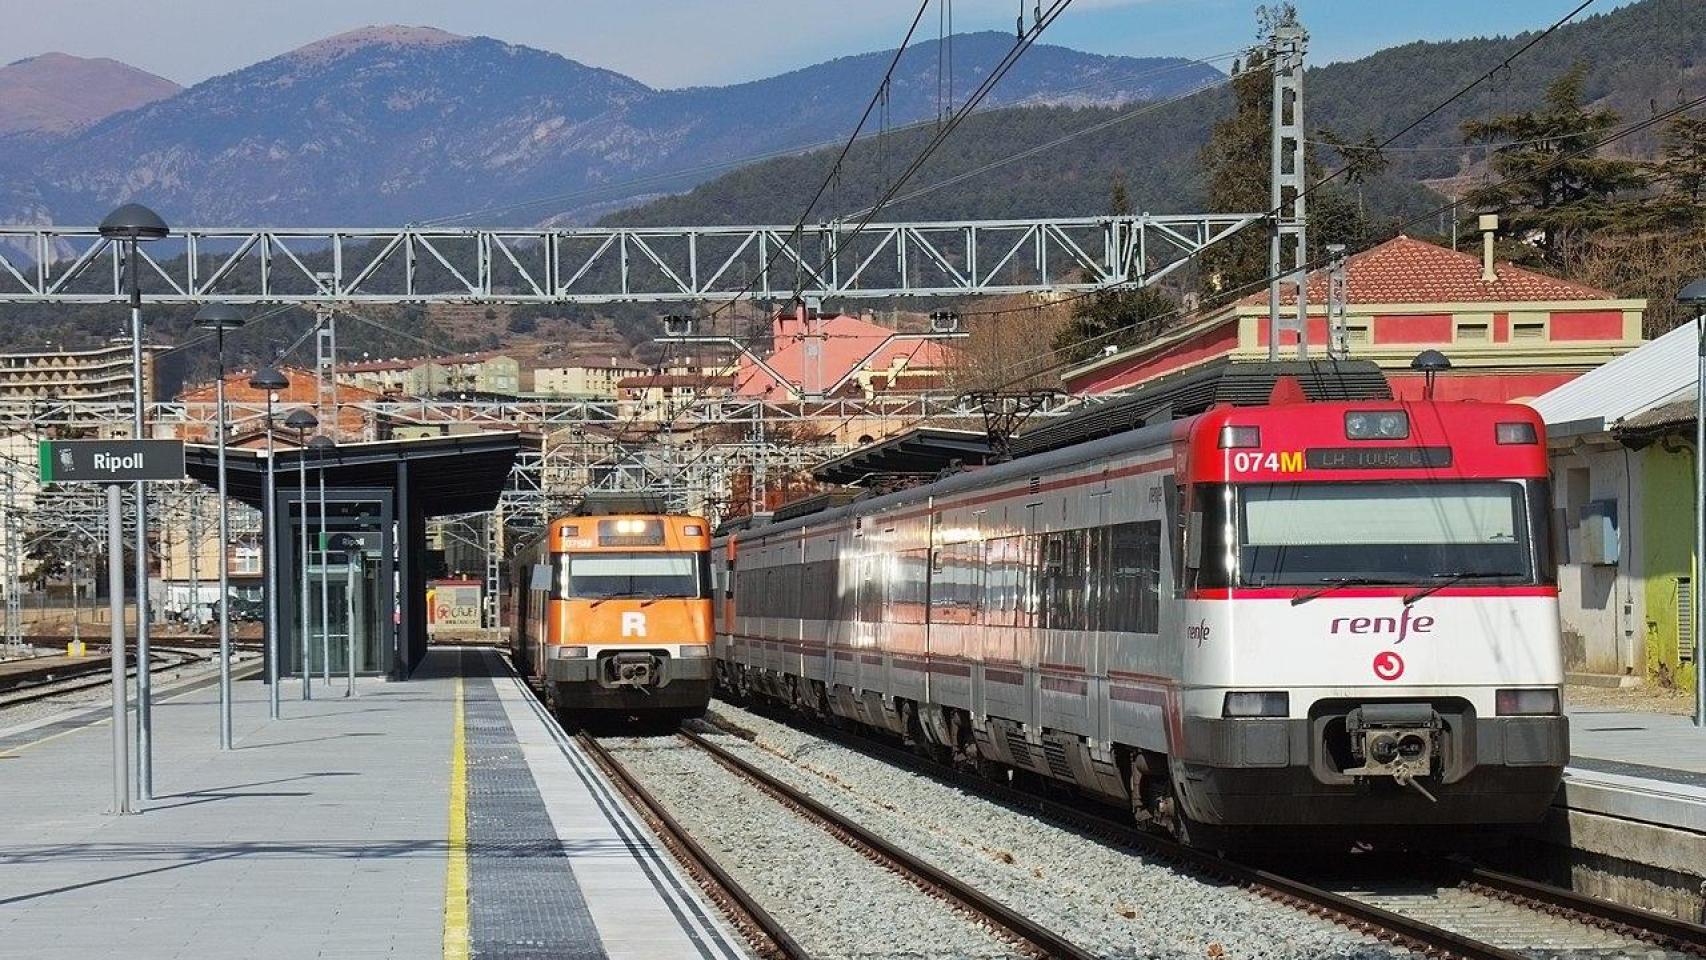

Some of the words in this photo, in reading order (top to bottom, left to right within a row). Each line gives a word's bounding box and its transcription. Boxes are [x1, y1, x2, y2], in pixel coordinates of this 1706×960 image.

[93, 451, 144, 472] Ripoll
[1233, 451, 1303, 473] 074M
[622, 611, 647, 637] R
[1186, 618, 1210, 648] renfe
[1330, 604, 1435, 645] renfe
